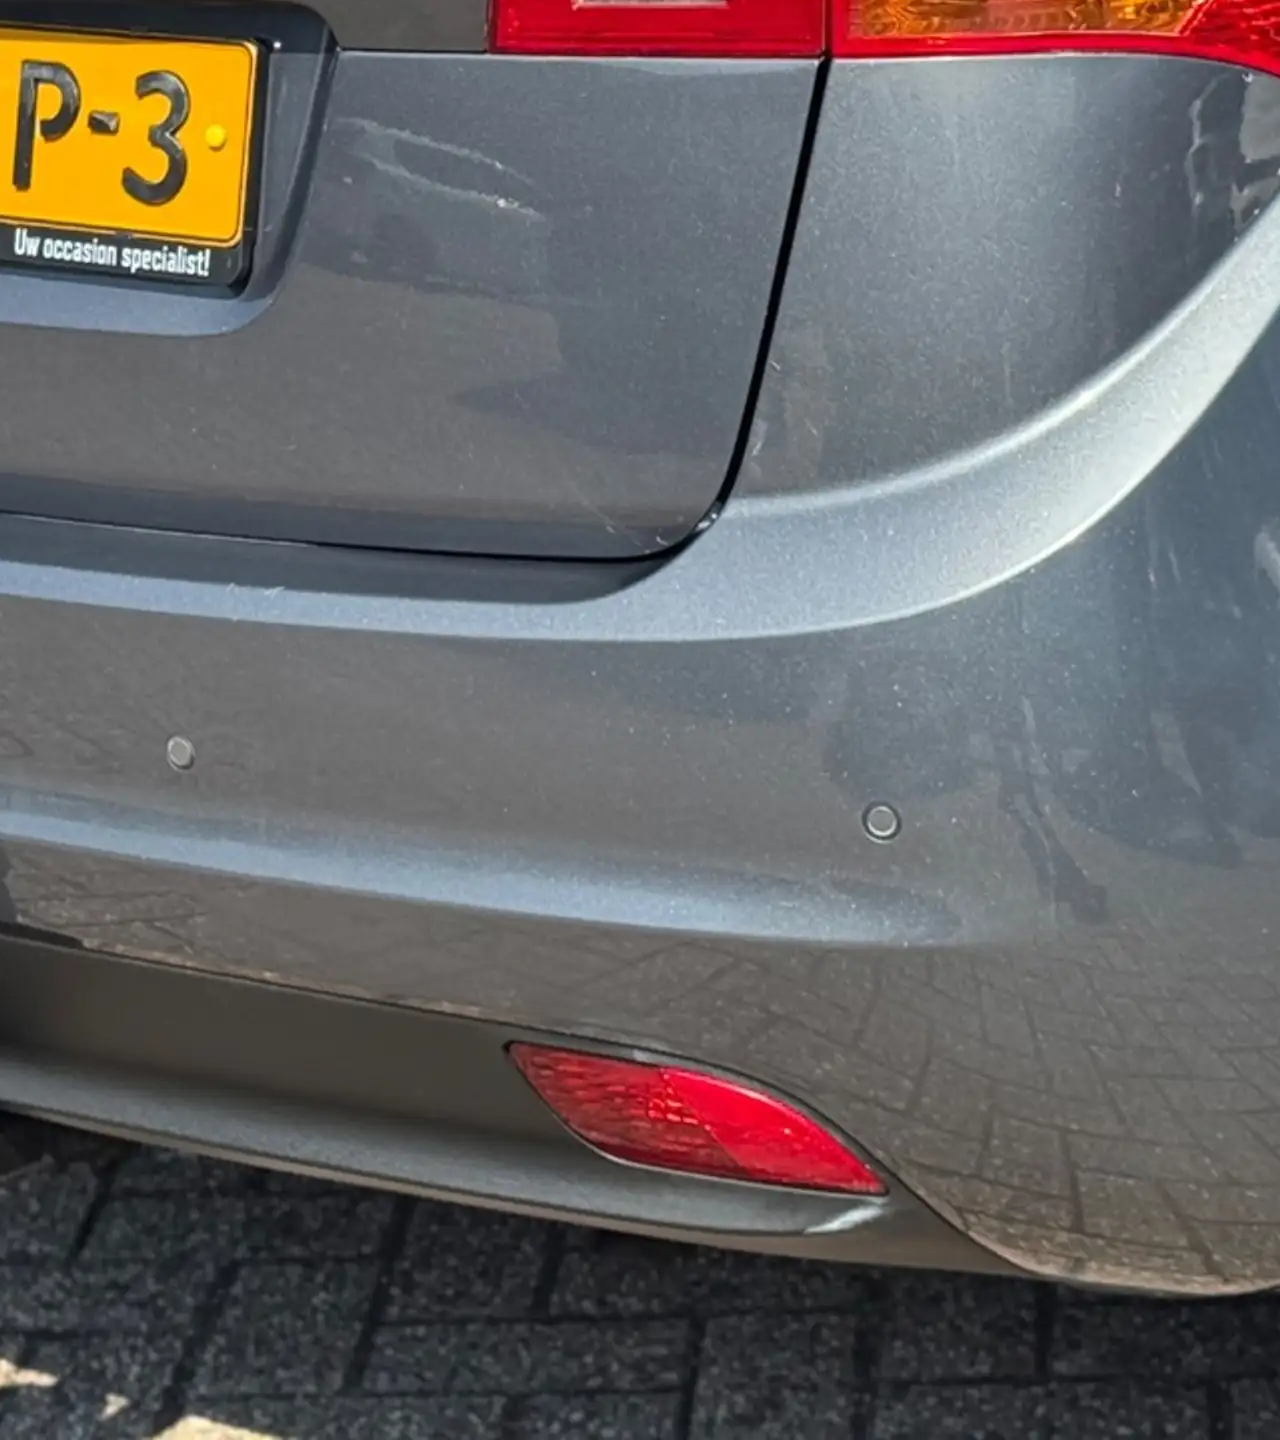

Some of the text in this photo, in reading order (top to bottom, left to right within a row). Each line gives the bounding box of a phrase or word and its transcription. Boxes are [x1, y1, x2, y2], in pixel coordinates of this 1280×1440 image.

[13, 227, 212, 278] Uw occasion specialist!
